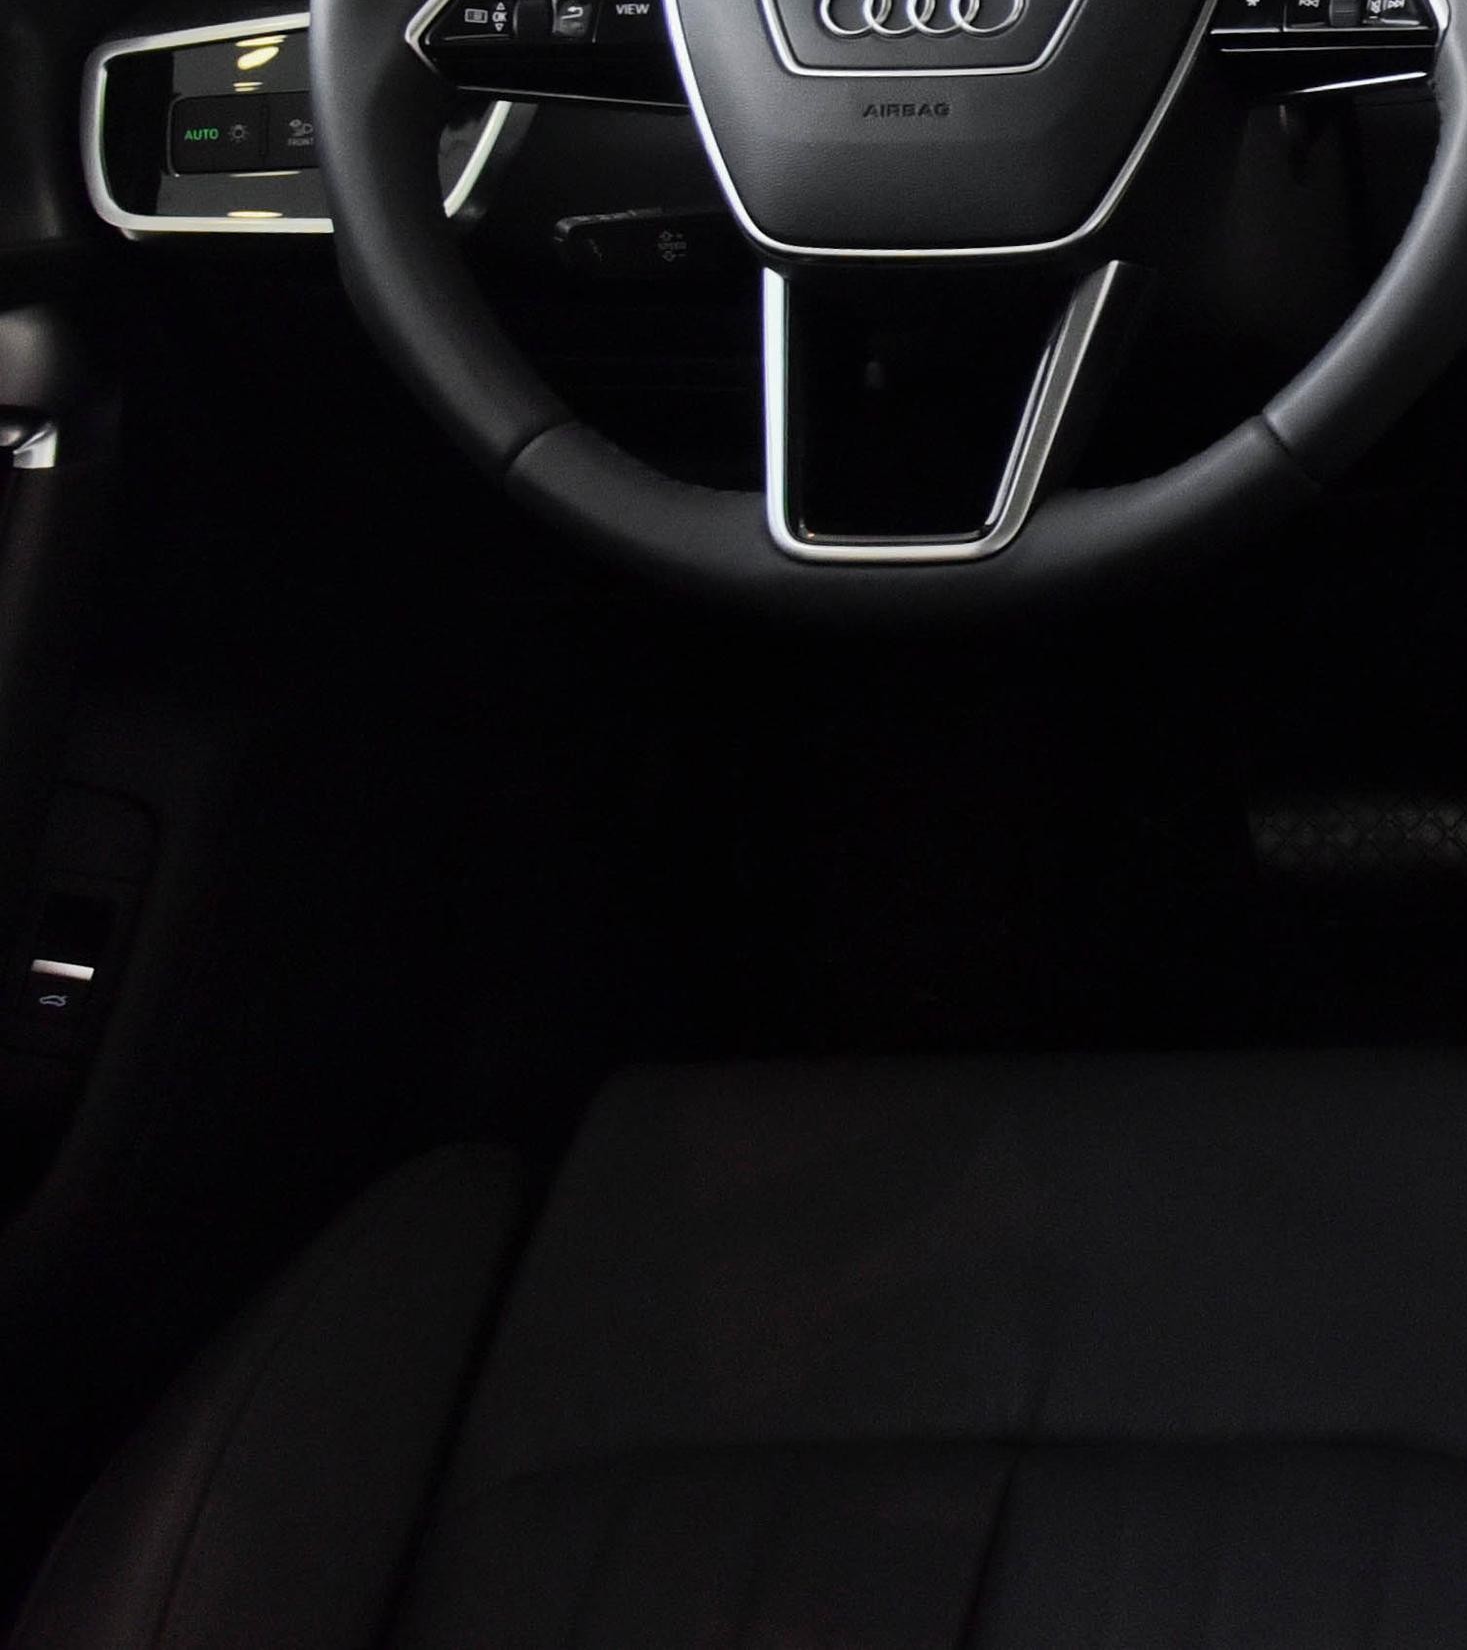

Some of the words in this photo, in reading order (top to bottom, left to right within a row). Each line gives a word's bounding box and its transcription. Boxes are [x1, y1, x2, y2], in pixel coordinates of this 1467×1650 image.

[615, 3, 650, 15] VIEW
[492, 10, 508, 23] OK
[862, 102, 951, 118] AIRBAG
[184, 128, 220, 141] AUTO
